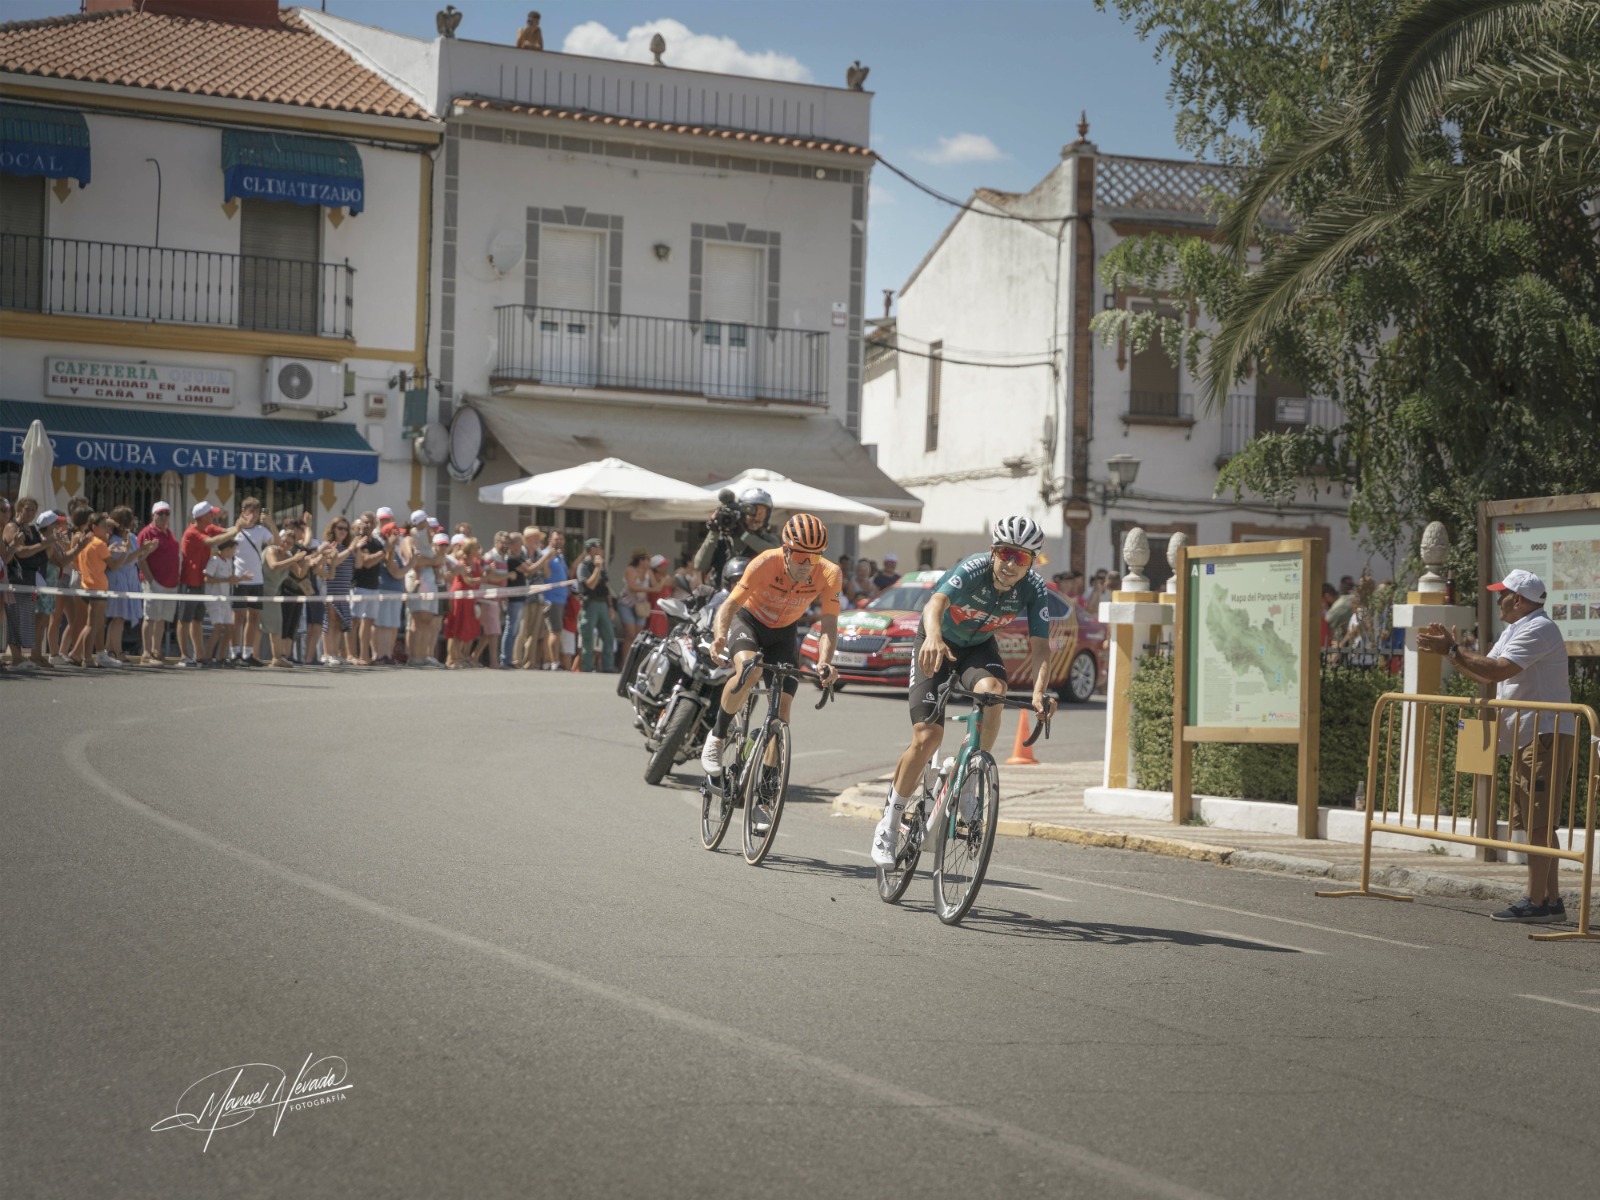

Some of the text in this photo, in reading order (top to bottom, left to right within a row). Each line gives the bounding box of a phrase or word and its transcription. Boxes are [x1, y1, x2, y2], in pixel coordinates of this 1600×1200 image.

[243, 176, 361, 202] CLIMATIZADO
[54, 361, 159, 380] CAFETERIA
[52, 375, 230, 394] ESPECIALIDAD EN JAMON
[70, 387, 79, 395] Y
[146, 392, 163, 400] DE
[177, 394, 213, 403] LOMO
[10, 435, 314, 474] BR ONUBA CAFETERIA
[961, 556, 987, 573] KERN
[1191, 564, 1199, 576] A
[960, 604, 1013, 625] KERN
